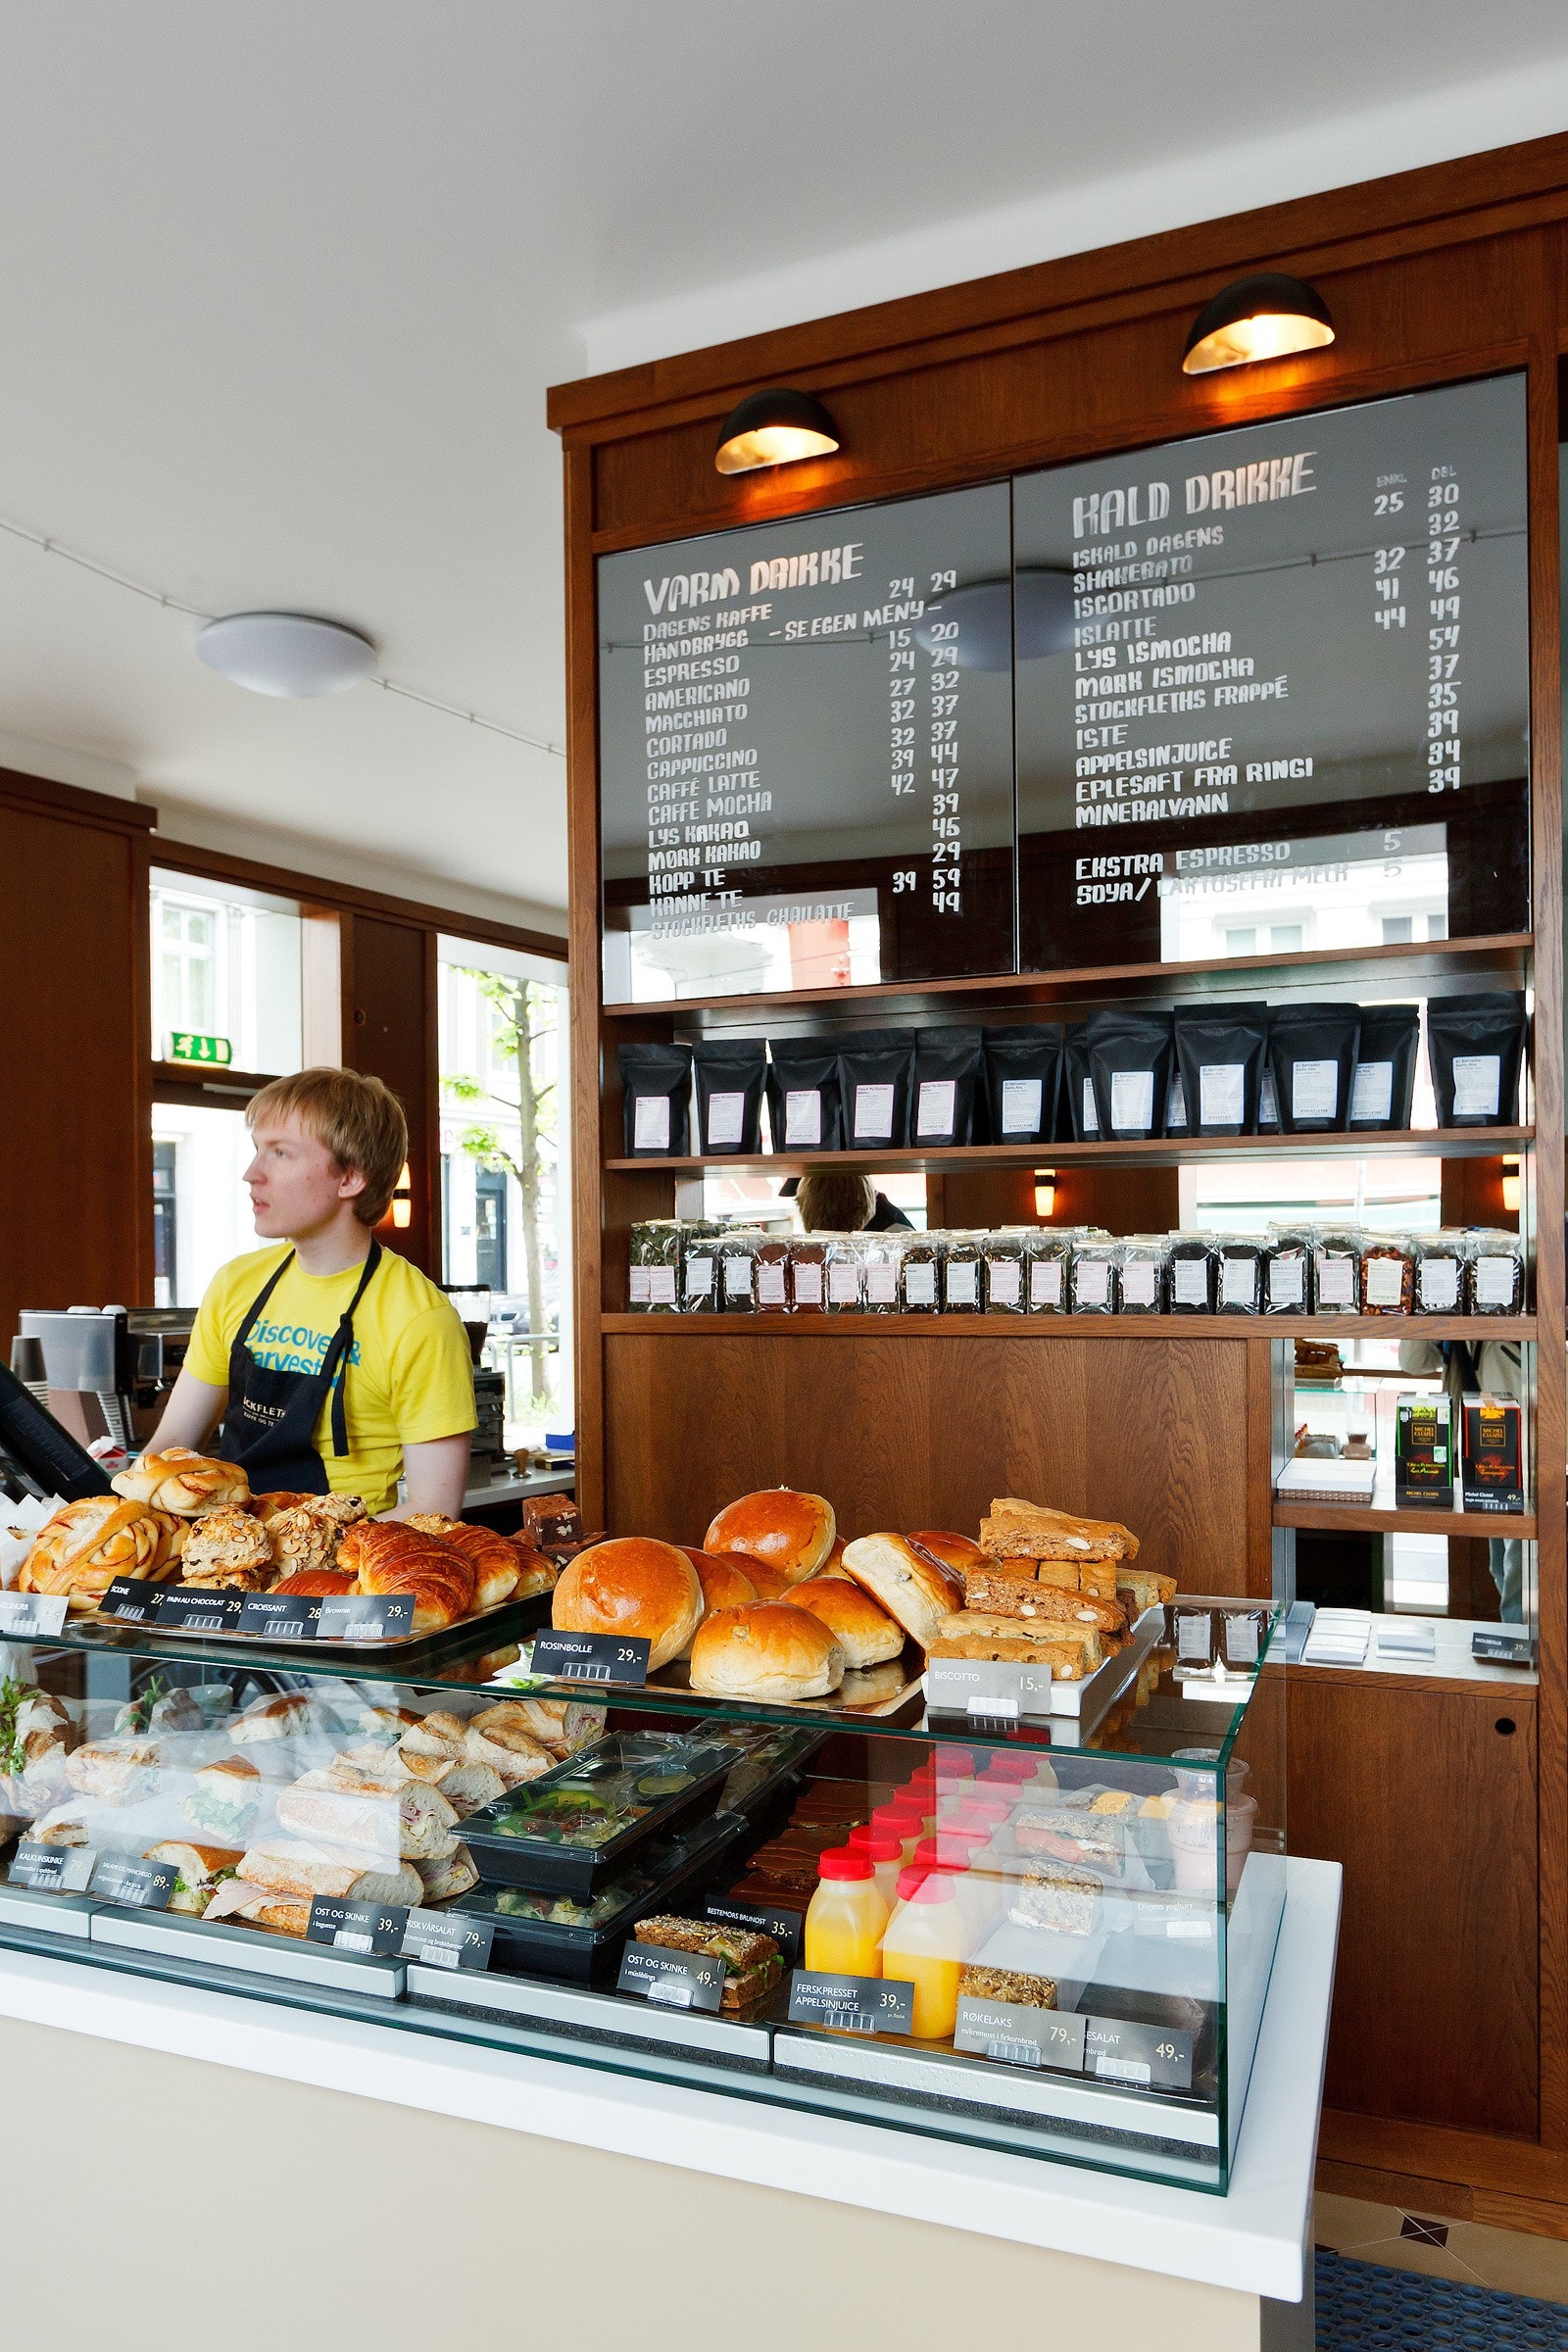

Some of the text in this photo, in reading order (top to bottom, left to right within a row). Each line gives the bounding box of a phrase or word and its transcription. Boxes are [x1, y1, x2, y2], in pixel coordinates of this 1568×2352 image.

[1072, 451, 1317, 538] KALD DRIKKE
[1073, 483, 1459, 569] ISKALD DAGENS 25 30
[1073, 511, 1460, 593] SHAKERATO 32
[644, 543, 864, 614] VARM DRIKKE
[1074, 537, 1461, 619] ISCORTADO 32 37
[644, 570, 956, 642] DAGENS KAFFE 24 29
[1074, 567, 1460, 648] ISLATTE 41 46
[644, 632, 749, 665] HÅNDBRYGG
[811, 614, 858, 635] EGEN
[645, 622, 958, 687] ESPRESSO 15 20
[1075, 596, 1460, 673] LYS ISMOCHA 44 49
[646, 647, 957, 711] AMERICANO 24 29
[1075, 625, 1460, 700] MØRK ISMOCHA 54
[646, 670, 959, 734] MACCHIATO 27 32
[1074, 654, 1460, 724] STOCKFLETHS FRAPPÉ 37
[646, 694, 958, 759] CORTADO 32 37
[1076, 681, 1462, 750] ISTE 35
[647, 720, 957, 780] CAPPUCCINO 32 37
[1075, 710, 1459, 777] APPELSINJUICE 39
[708, 770, 761, 794] LATTE
[892, 749, 914, 770] 39
[931, 742, 957, 763] 44
[1076, 739, 1461, 804] EPLESAFT FRA RINGI 34
[706, 791, 772, 818] MOCHA
[891, 773, 915, 796] 42
[931, 768, 959, 789] 47
[1076, 765, 1460, 828] MINERALVANN 39
[648, 793, 959, 849] LYS KAKAO 39
[648, 816, 960, 872] MØRK KAKAO 45
[1076, 831, 1401, 880] EKSTRA ESPRESSO 5
[649, 841, 960, 895] KOPP TE 29
[1383, 860, 1402, 878] 5
[650, 868, 960, 918] KANNE TE 39 59
[932, 892, 960, 913] 49
[245, 1319, 332, 1355] Discove
[247, 1346, 322, 1376] arvest
[151, 1593, 165, 1606] 27,
[226, 1601, 242, 1614] 29,
[248, 1603, 287, 1612] CROISSANT
[387, 1606, 408, 1618] 29,-
[540, 1642, 593, 1653] ROSINBOLLE
[616, 1648, 642, 1664] 29,-
[934, 1670, 980, 1682] BISCOTTO
[1020, 1677, 1044, 1692] 15,-
[315, 1907, 370, 1924] OST OG SKINKE
[377, 1918, 399, 1934] 39,-
[707, 1907, 766, 1925] BESTEMORS BRUNOST
[1138, 1902, 1193, 1912] Dagens yoghurt
[465, 1931, 486, 1948] 79,-
[771, 1921, 793, 1937] 35,-
[627, 1954, 688, 1975] OST OG SKINKE
[696, 1971, 717, 1987] 49,-
[795, 1996, 859, 2011] APPELSINJUICE
[796, 1984, 858, 1998] FERSKPRESSET
[879, 1992, 906, 2010] 39,-
[962, 2011, 1012, 2028] RØKELAKS
[1050, 2026, 1077, 2045] 79,-
[1085, 2031, 1121, 2045] ESALAT
[1155, 2042, 1185, 2062] 49,-
